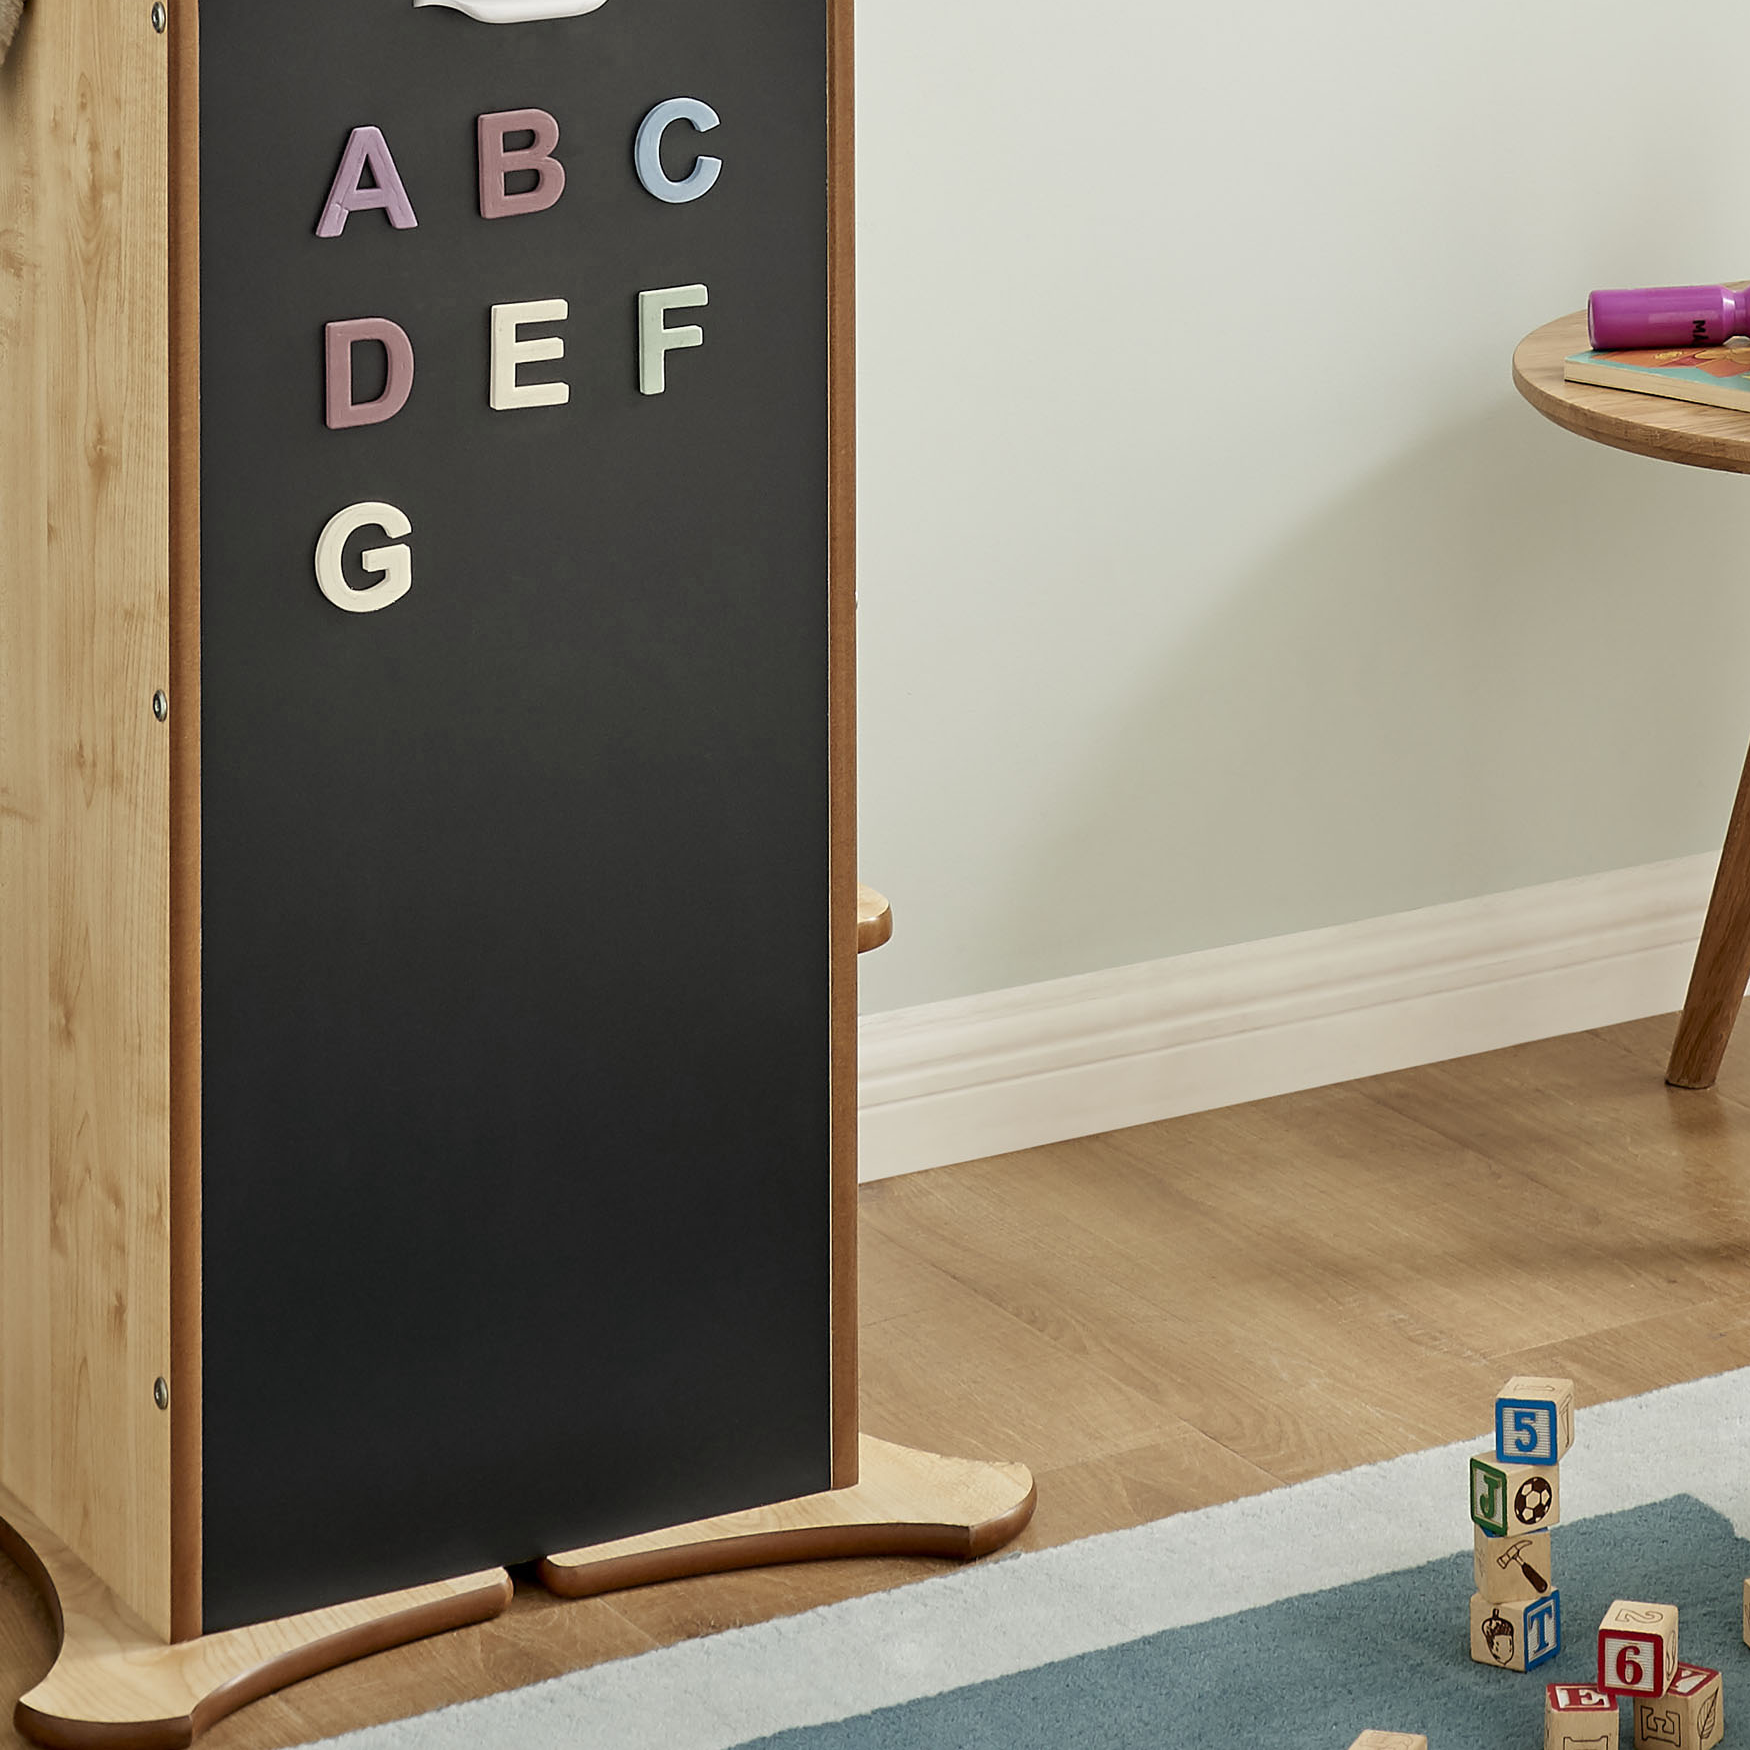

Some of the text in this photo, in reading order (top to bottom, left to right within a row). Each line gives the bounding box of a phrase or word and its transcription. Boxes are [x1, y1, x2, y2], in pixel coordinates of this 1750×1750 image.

[314, 96, 723, 239] A B C
[325, 283, 709, 430] D E F
[315, 501, 413, 613] G
[1514, 1411, 1538, 1452] 5
[1480, 1474, 1500, 1519] J
[1530, 1604, 1553, 1655] T
[1616, 1645, 1644, 1685] 6
